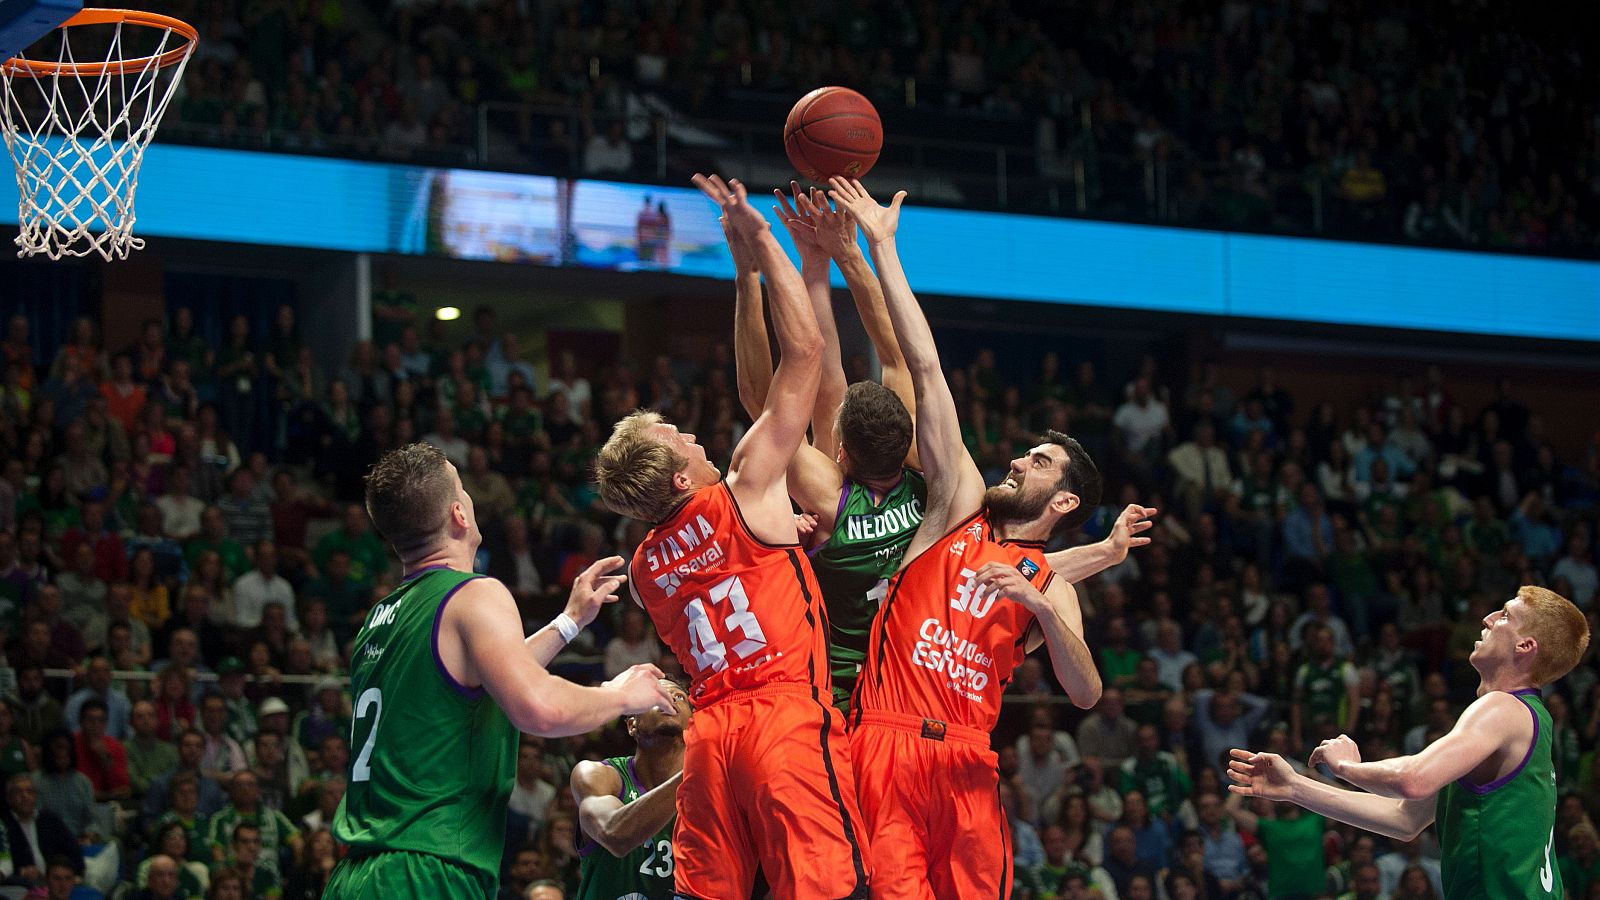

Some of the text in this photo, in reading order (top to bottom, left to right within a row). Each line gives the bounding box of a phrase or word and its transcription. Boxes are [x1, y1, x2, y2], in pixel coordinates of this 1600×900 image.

[683, 574, 768, 673] 43
[974, 652, 993, 668] del
[639, 838, 674, 878] 23
